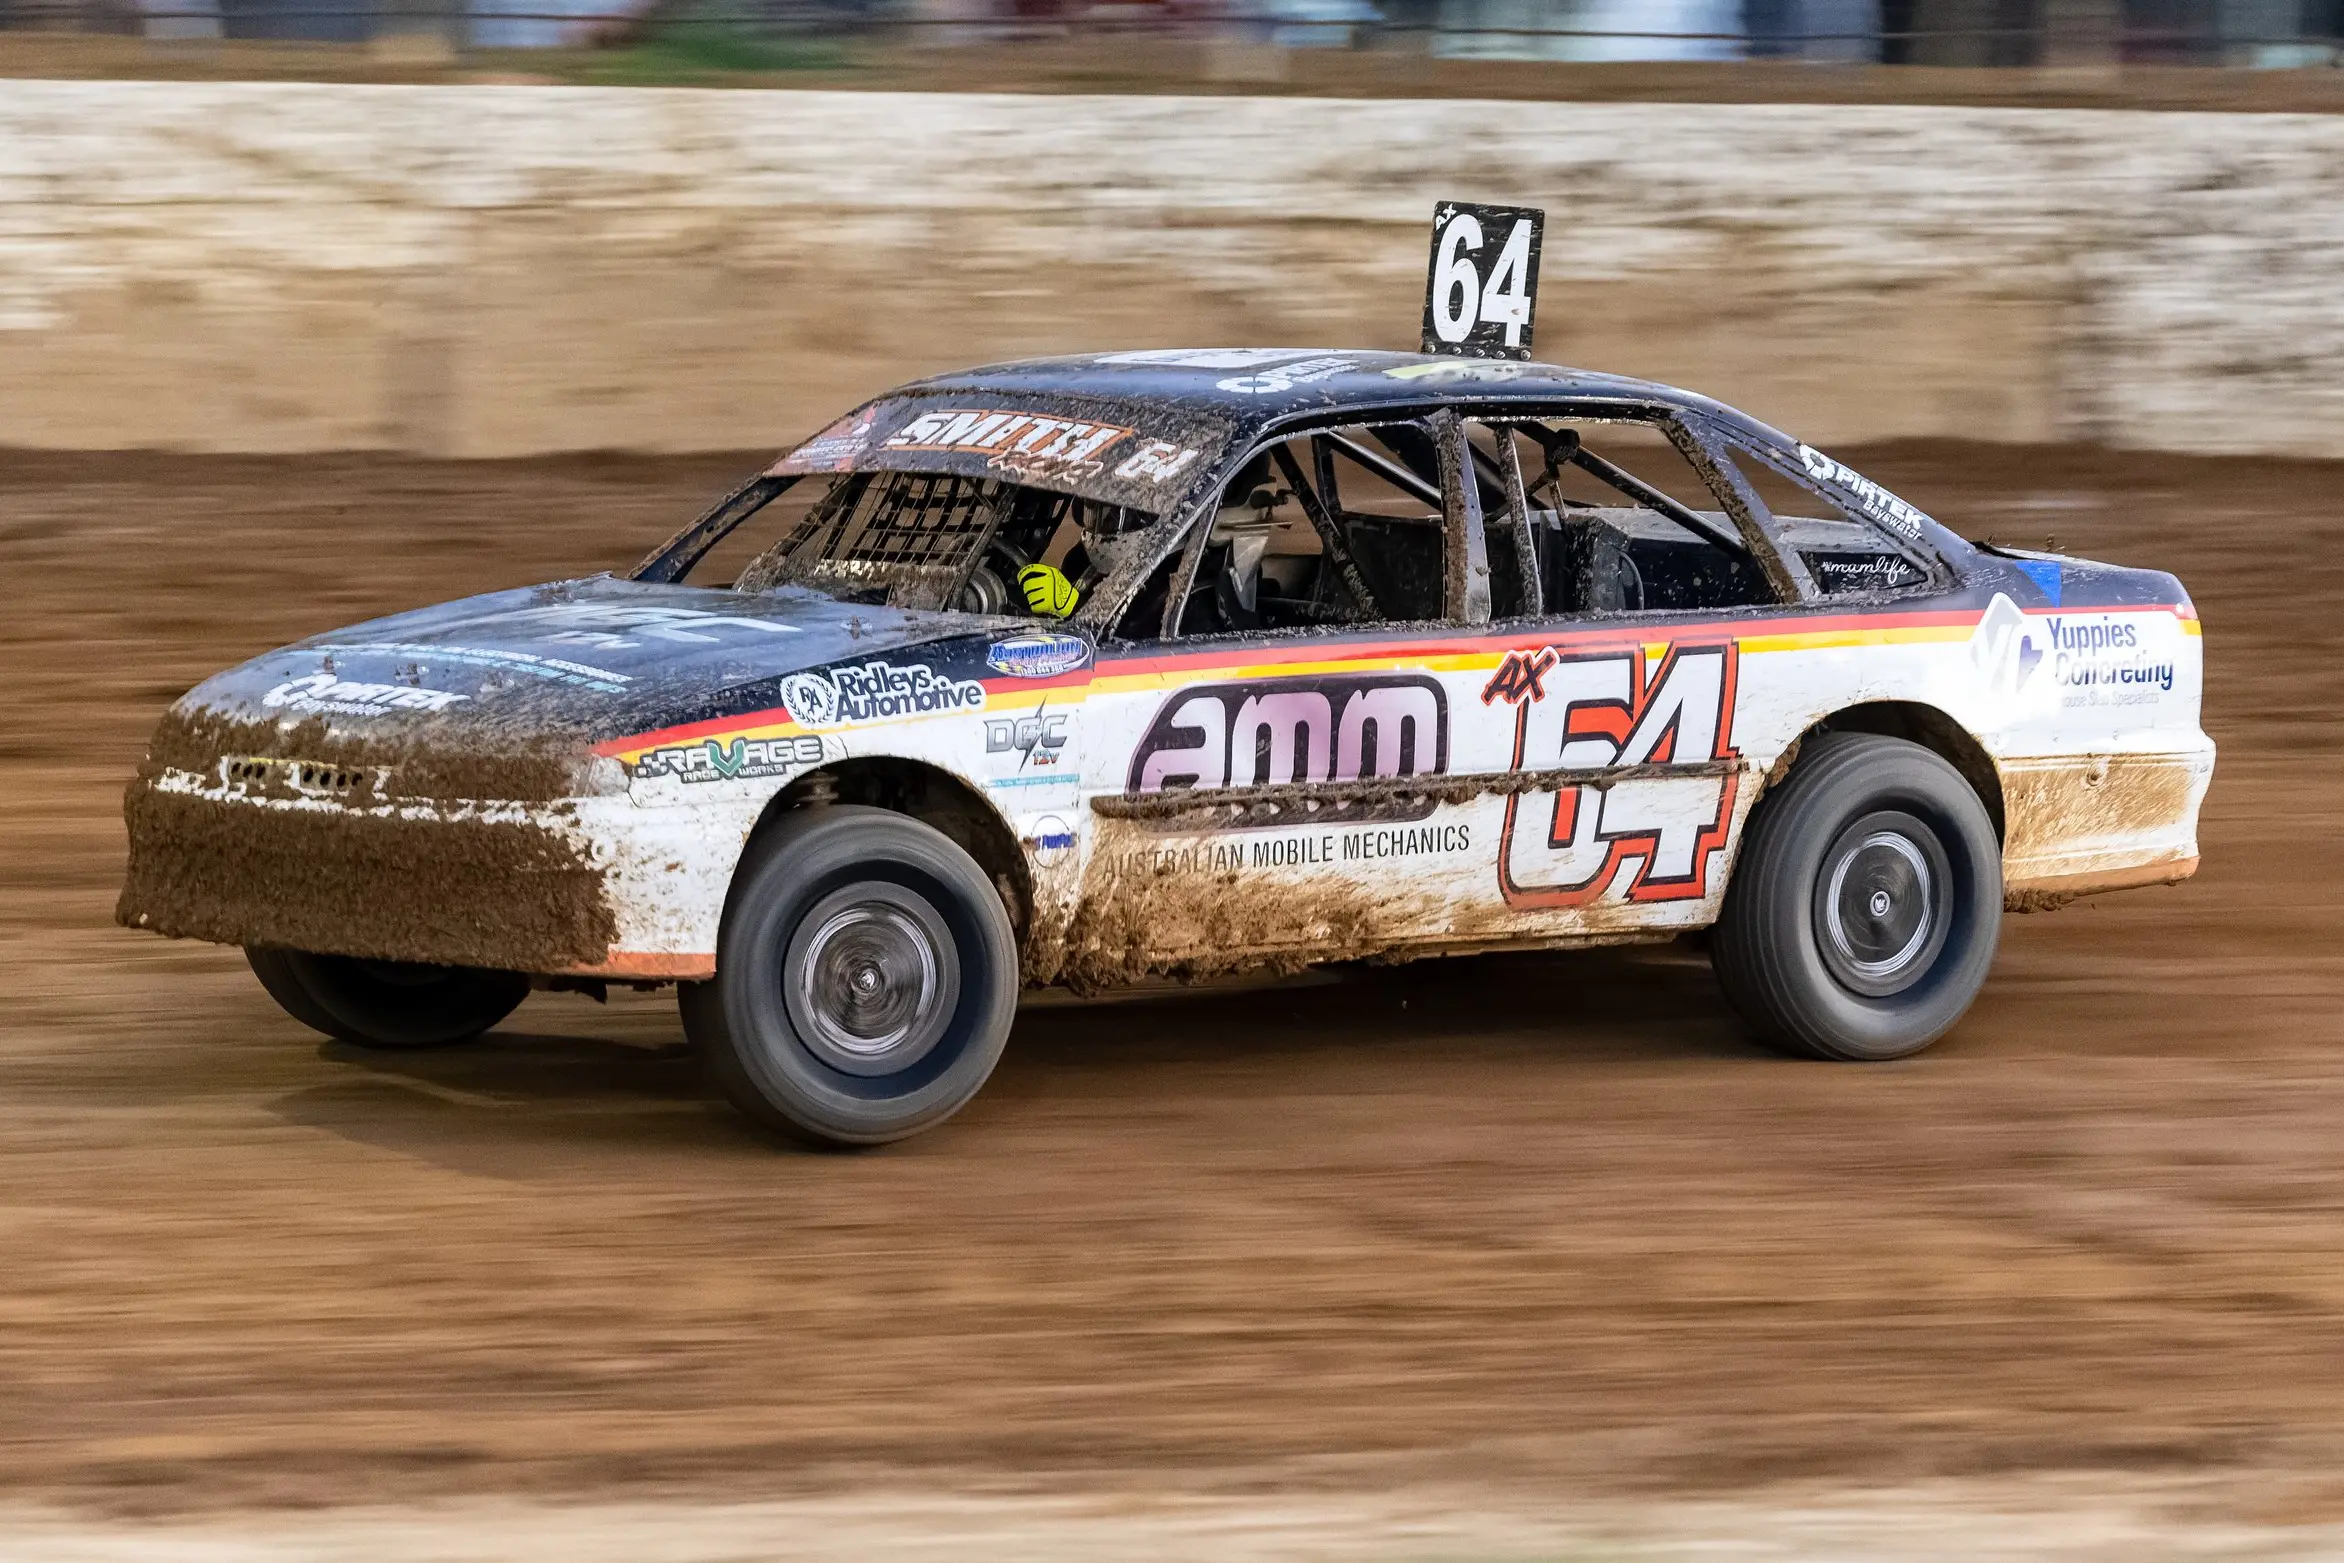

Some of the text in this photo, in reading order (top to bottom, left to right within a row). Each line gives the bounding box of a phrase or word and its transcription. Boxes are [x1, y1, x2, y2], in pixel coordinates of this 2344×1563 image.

[1436, 204, 1456, 230] AX
[1433, 214, 1532, 346] 64
[886, 410, 1130, 462] SMITH
[1114, 437, 1199, 483] 64
[1836, 466, 1925, 529] PIRTEK
[1863, 500, 1924, 541] Bayswater
[2047, 616, 2137, 657] Yuppies
[836, 664, 931, 698] Ridleys
[1481, 647, 1559, 706] AX
[835, 681, 982, 722] Automotive
[656, 738, 821, 776] RAVAGE
[683, 764, 784, 782] RACE WORKS
[1137, 685, 1439, 816] amm
[1498, 636, 1742, 912] 64
[1104, 825, 1470, 879] AUSTRALIAN MOBILE MECHANICS
